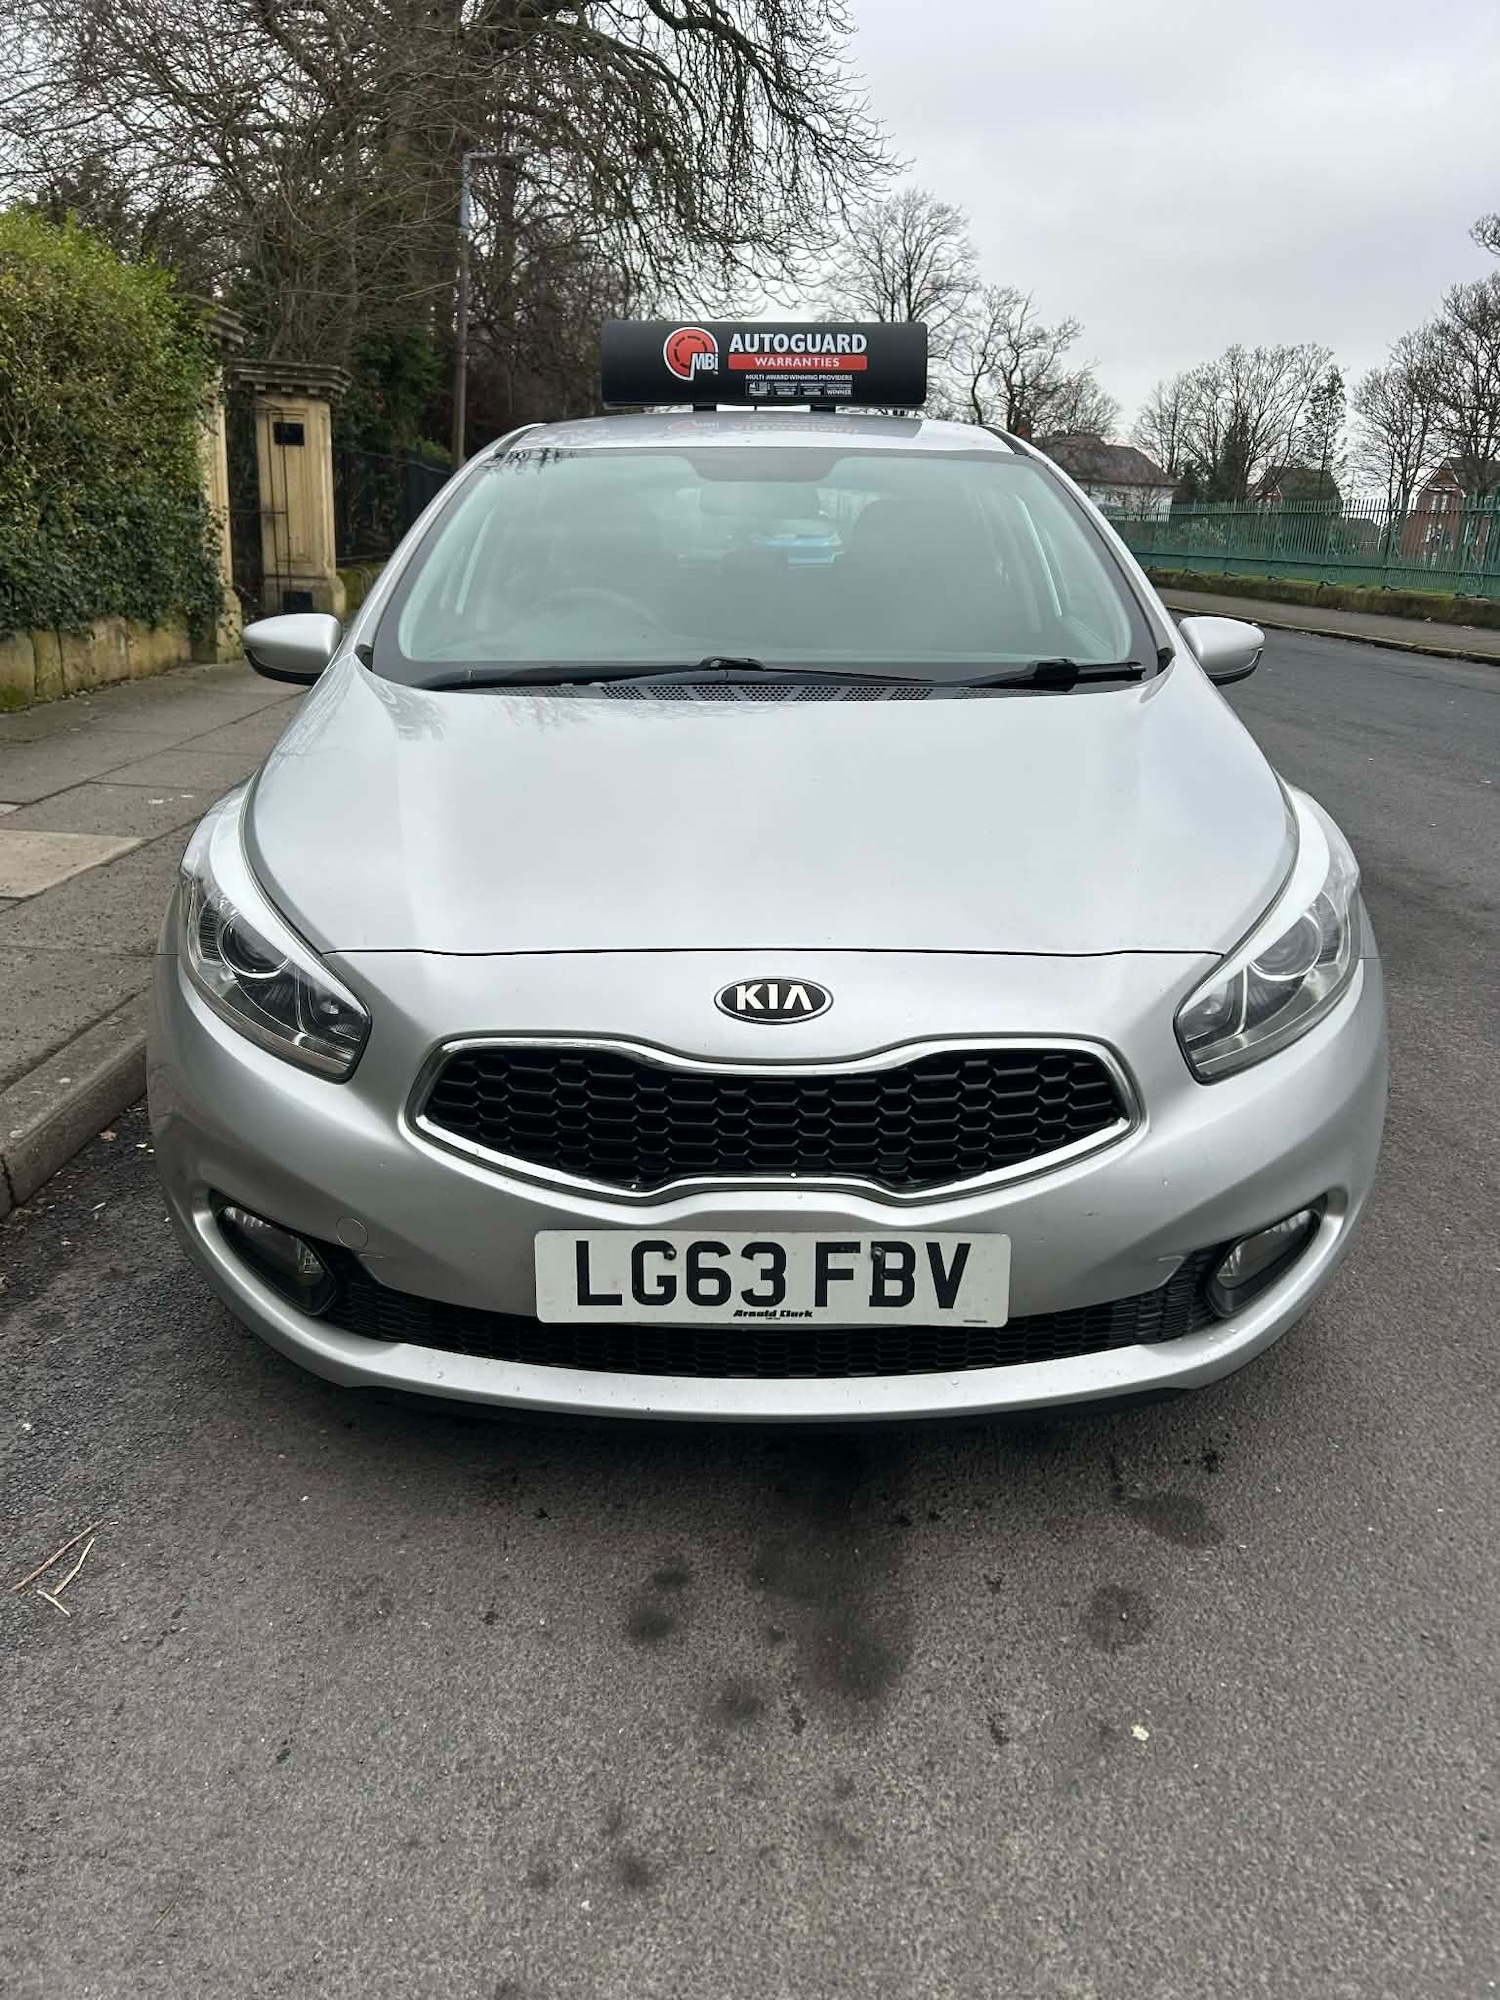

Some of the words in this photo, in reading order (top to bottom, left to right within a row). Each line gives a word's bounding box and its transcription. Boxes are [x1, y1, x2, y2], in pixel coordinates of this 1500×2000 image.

[729, 333, 867, 353] AUTOGUARD
[693, 353, 718, 371] MBi
[755, 356, 840, 368] WARRANTIES
[735, 983, 813, 1010] KIA
[575, 1240, 787, 1308] LG63
[814, 1241, 972, 1309] FBV
[733, 1309, 778, 1319] Arnold
[779, 1309, 813, 1319] Clark
